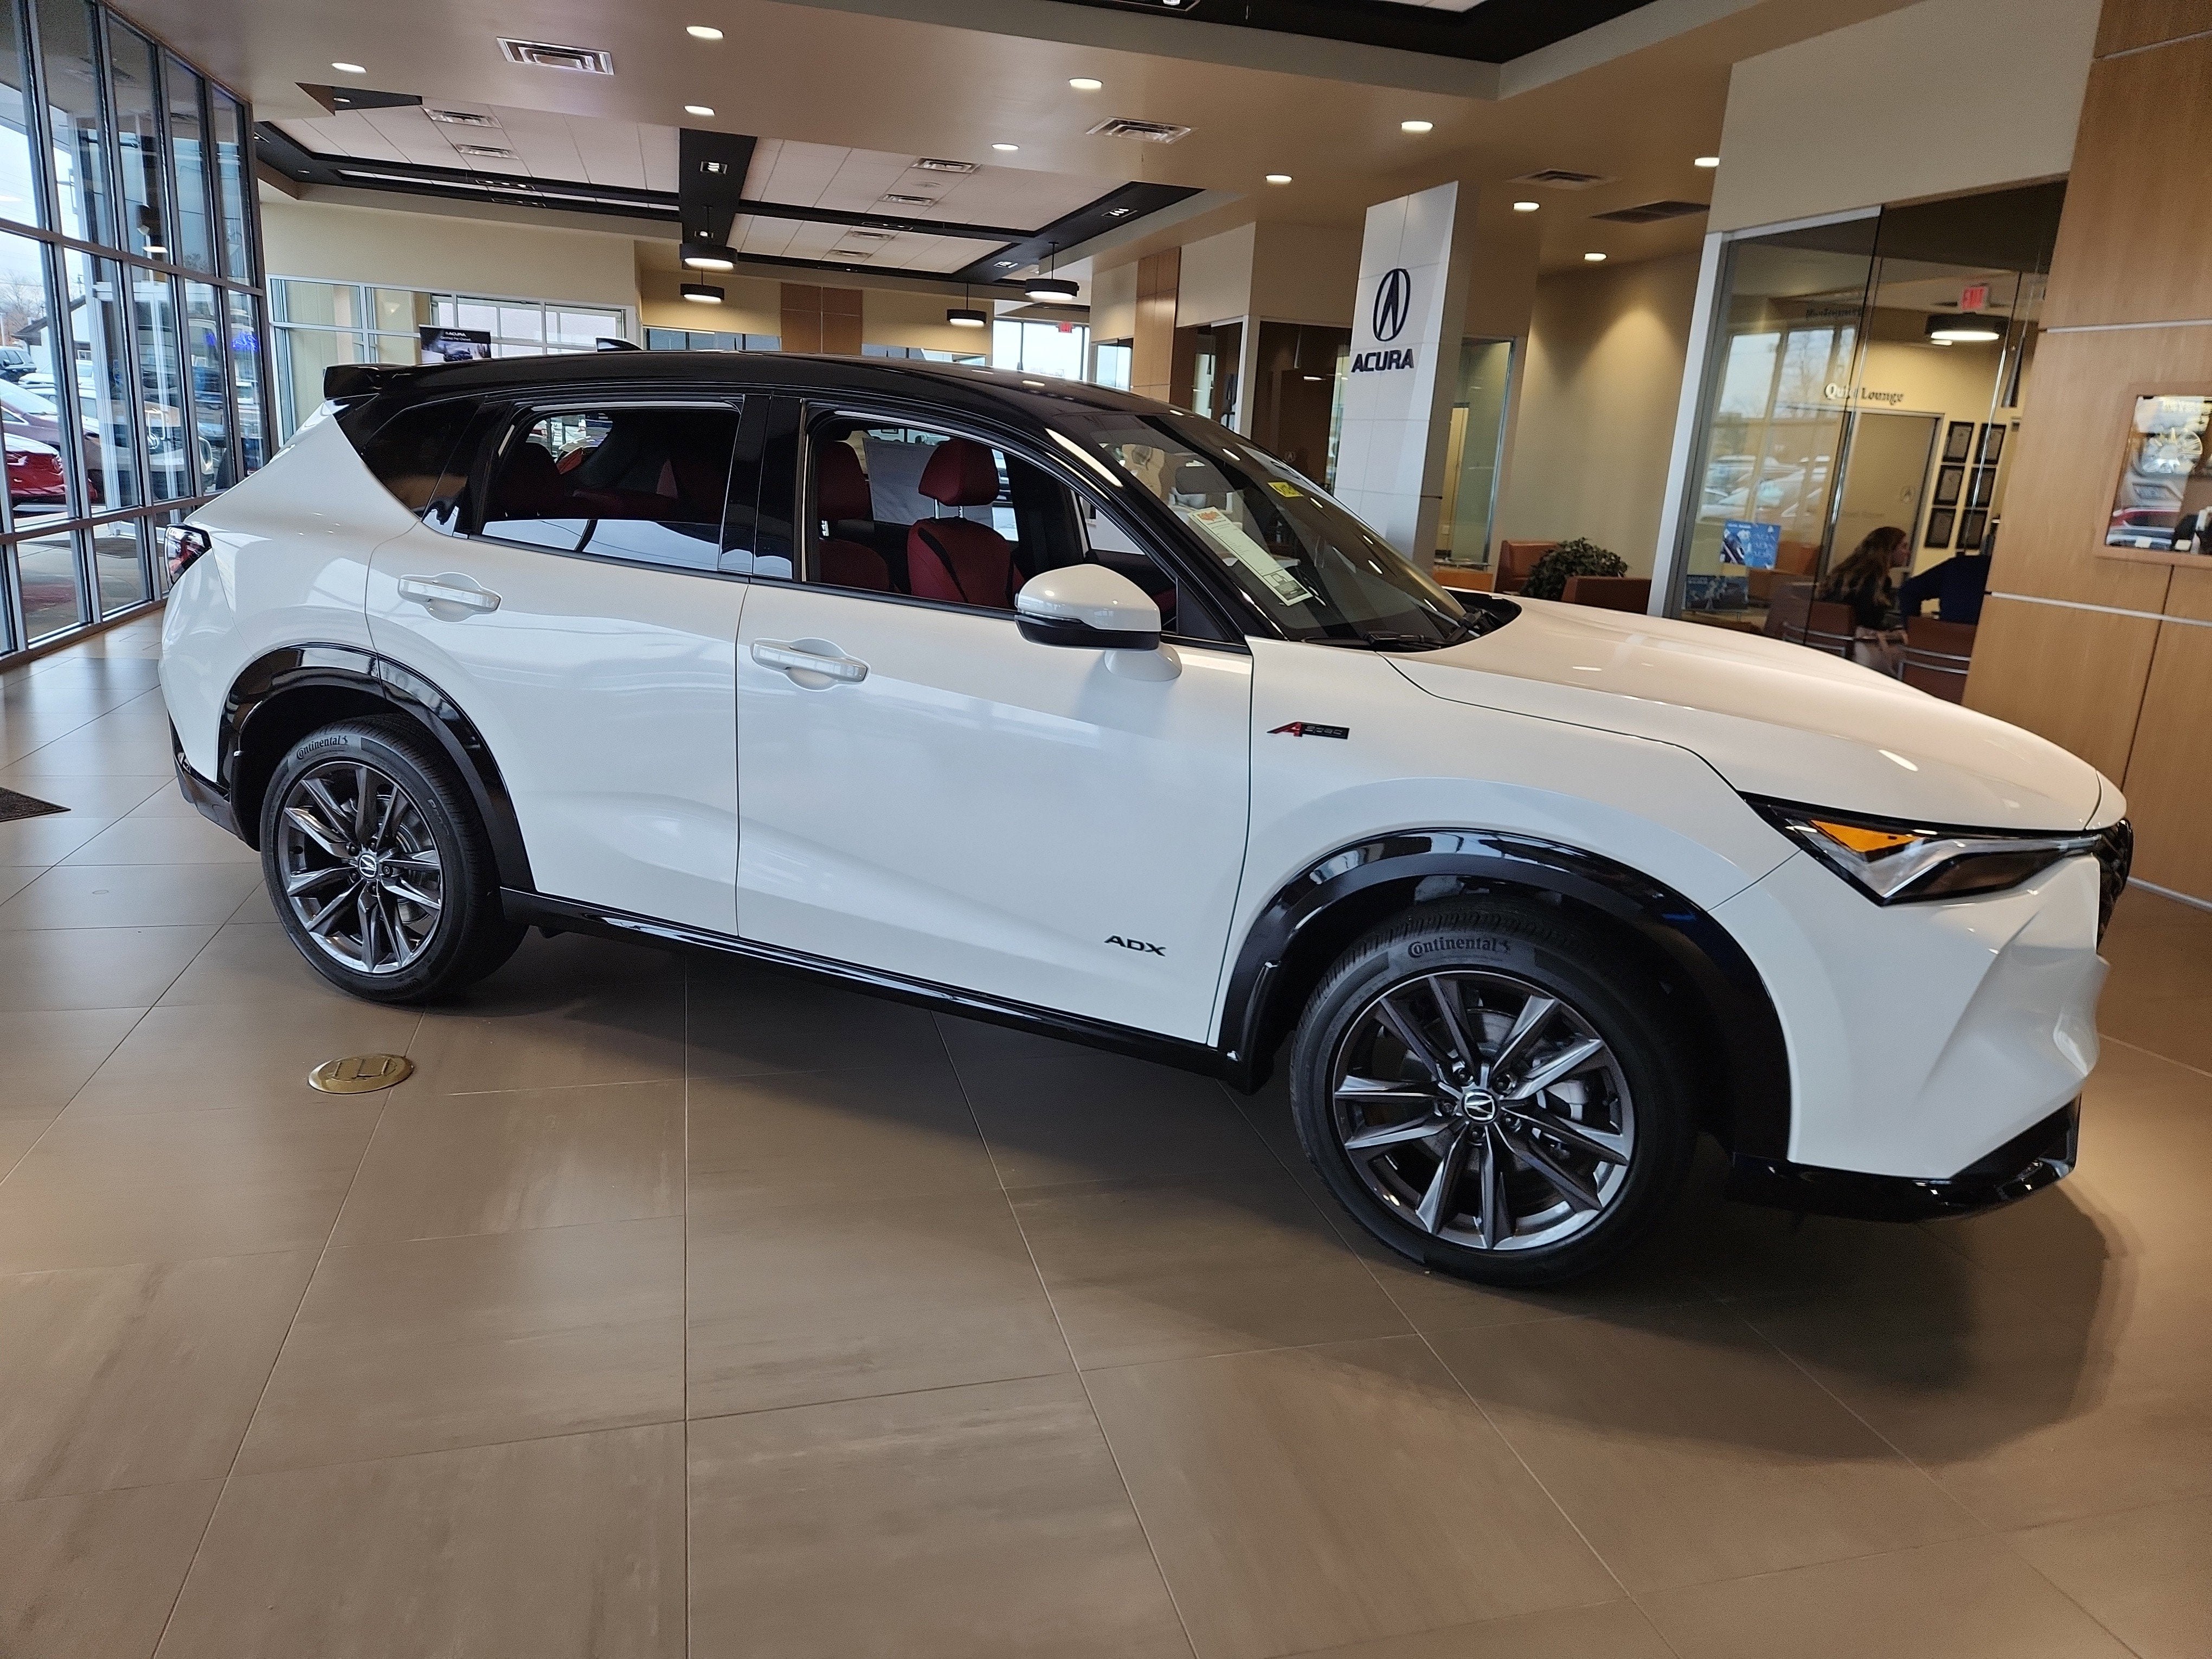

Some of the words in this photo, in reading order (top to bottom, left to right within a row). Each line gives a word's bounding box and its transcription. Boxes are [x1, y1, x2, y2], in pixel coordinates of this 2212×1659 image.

[1351, 348, 1414, 372] ACURA
[1861, 388, 1904, 406] Lounge
[297, 735, 341, 760] Continental
[1104, 935, 1166, 957] ADX
[1408, 937, 1497, 958] Continental
